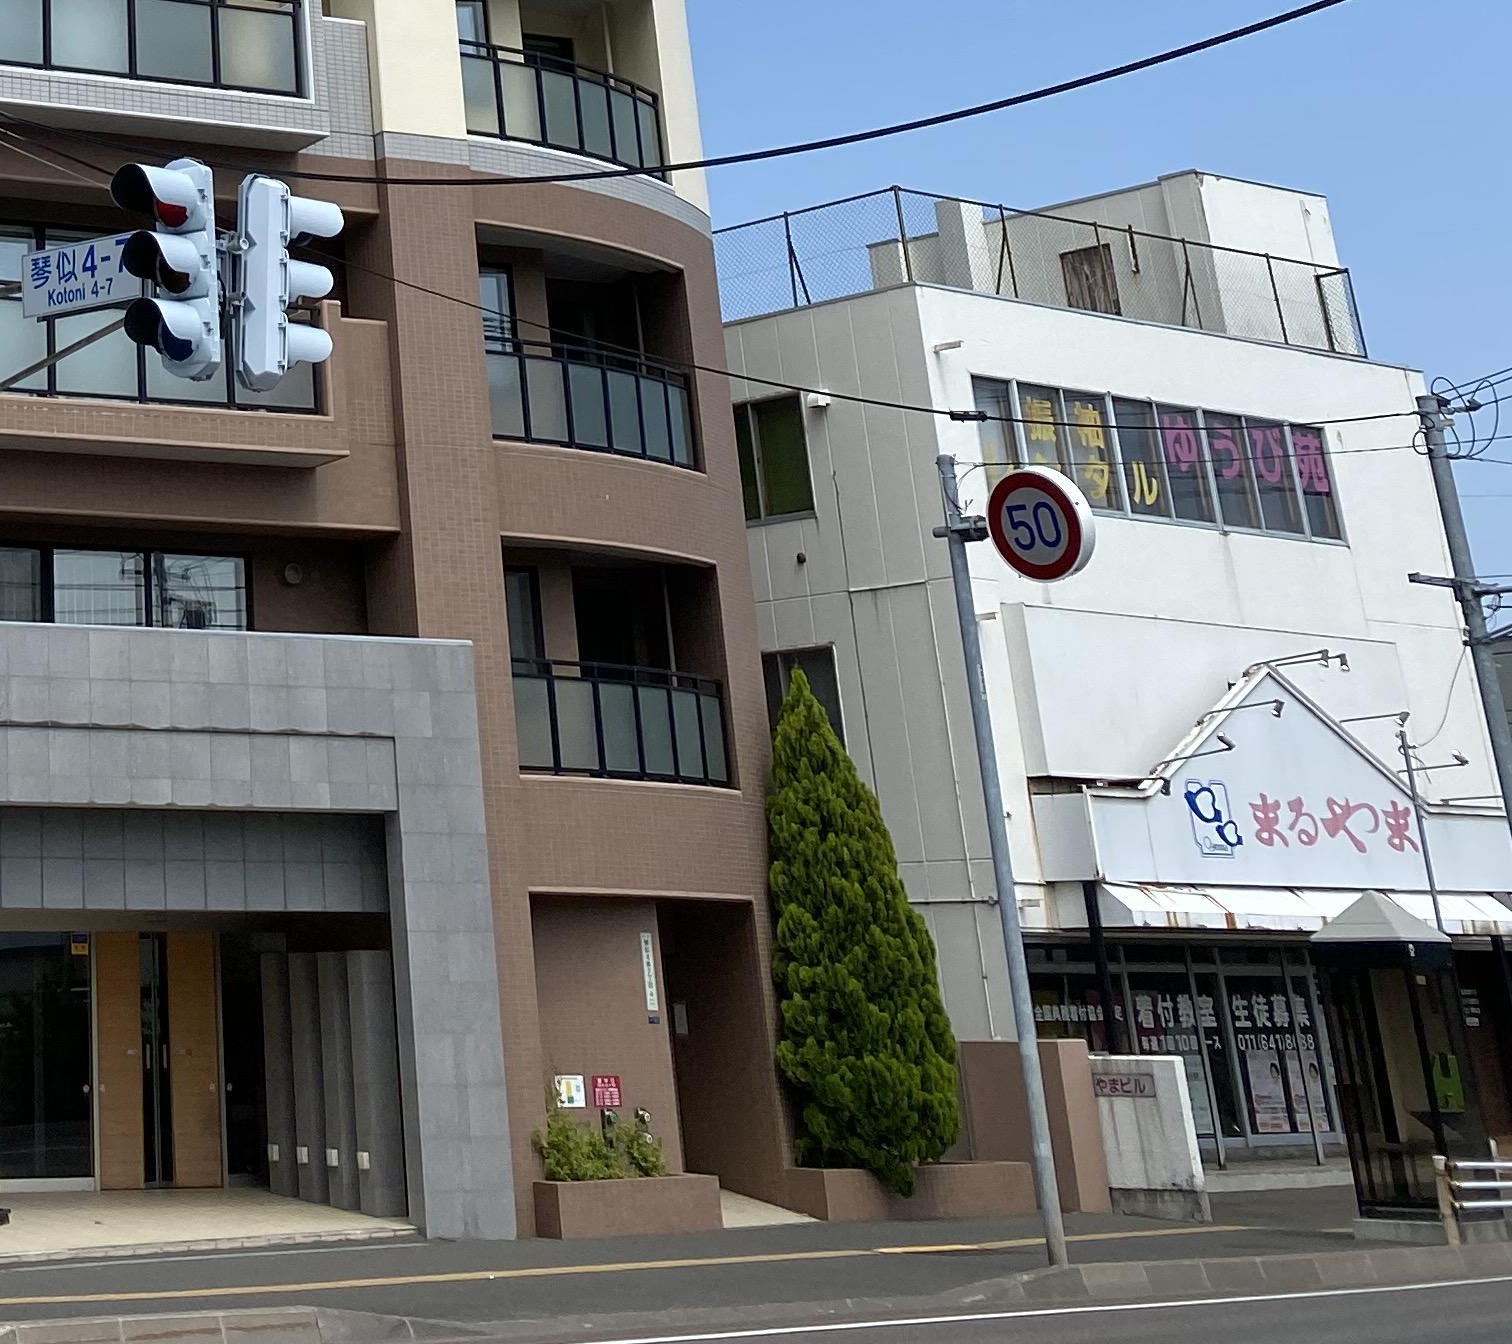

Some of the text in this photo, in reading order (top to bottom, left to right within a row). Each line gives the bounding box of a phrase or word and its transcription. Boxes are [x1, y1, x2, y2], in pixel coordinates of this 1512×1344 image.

[48, 277, 113, 307] Kotoni 4-7
[1026, 396, 1105, 449] 振袖
[1006, 502, 1062, 551] 50
[1249, 792, 1420, 854] まるやま
[1136, 993, 1218, 1029] 着付教室
[1231, 993, 1311, 1028] 生徒募集
